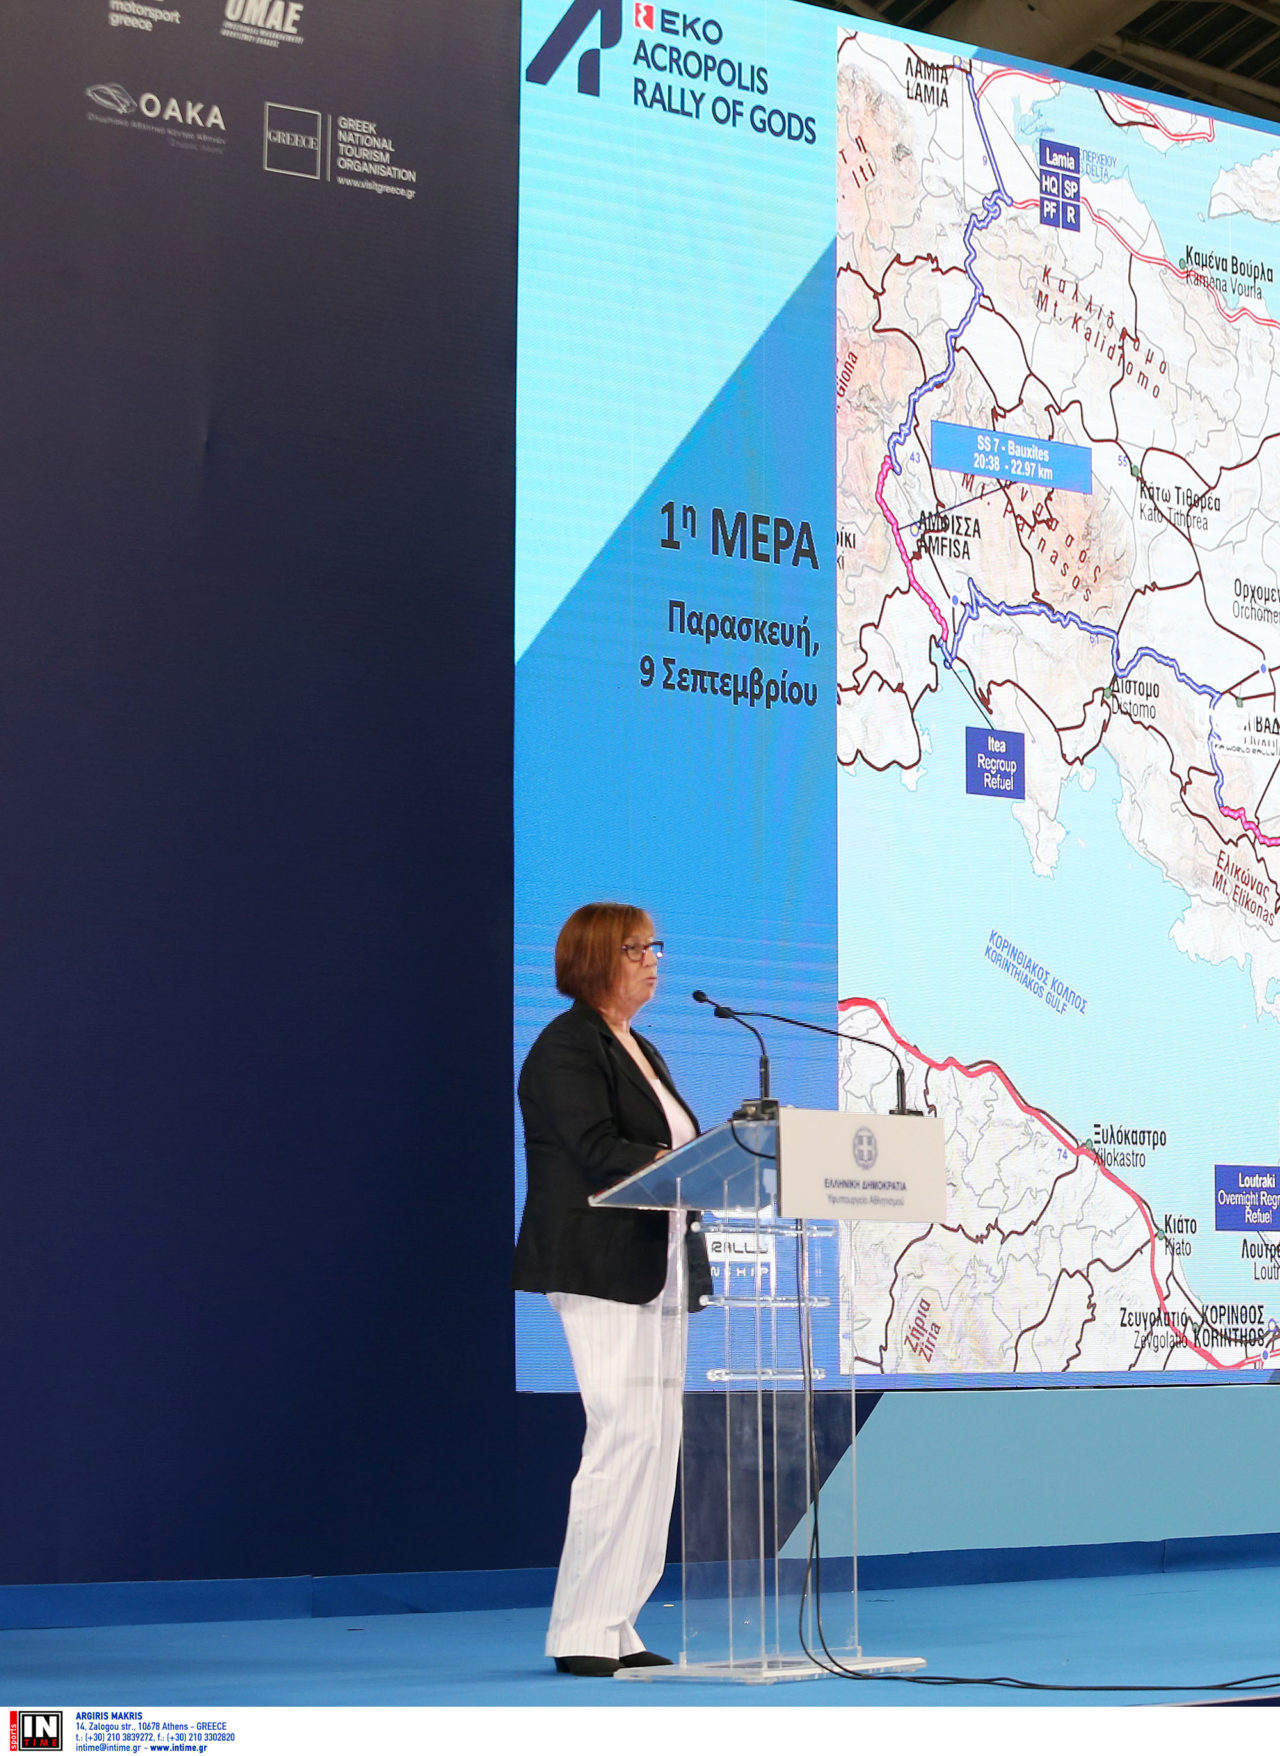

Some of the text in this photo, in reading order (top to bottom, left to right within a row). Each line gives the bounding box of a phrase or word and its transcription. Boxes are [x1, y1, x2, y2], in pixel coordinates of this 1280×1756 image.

[108, 12, 153, 31] greece
[109, 0, 181, 24] motorsport
[661, 9, 723, 45] EKO
[633, 39, 769, 95] ACROPOLIS
[906, 79, 949, 108] LAMIA
[634, 77, 817, 145] RALLY OF GODS
[337, 116, 377, 135] GREEK
[268, 130, 319, 151] GREECE
[337, 130, 395, 152] NATIONAL
[337, 144, 390, 164] TOURISM
[1045, 146, 1075, 170] Lamia
[337, 157, 417, 183] ORGANISATION
[337, 176, 416, 199] www.visitgreece.gr
[1042, 174, 1078, 200] HQ SP
[1043, 202, 1076, 225] PF R
[1186, 245, 1274, 283] Καμένα Βούρλα
[1231, 277, 1262, 300] Vourla
[837, 351, 858, 399] Giona
[977, 434, 1049, 462] SS Bauxites
[974, 454, 1053, 480] 20:38 22.97 km
[1139, 480, 1171, 503] Κάτω
[712, 508, 820, 570] ΜΕΡΑ
[920, 534, 970, 560] AMFISA
[668, 599, 820, 657] Παρασκευή,
[640, 655, 818, 709] 9 Σεπτεμβρίου
[1112, 698, 1157, 719] Distomo
[988, 736, 1006, 753] Itea
[977, 755, 1017, 775] Regroup
[984, 771, 1014, 792] Refuel
[1217, 850, 1270, 904] Ελικώνας
[1212, 871, 1275, 927] Mt. Elikonas
[984, 945, 1067, 1015] KORINTHIAKOS GULF
[989, 929, 1088, 1015] ΚΟΡΙΝΘΙΑΚΟΣ ΚΟΛΠΟΣ
[1094, 1124, 1166, 1151] Ξυλόκαστρο
[1239, 1173, 1276, 1189] Loutraki
[1218, 1190, 1258, 1207] Overnight
[1164, 1214, 1197, 1235] Κιάτο
[1245, 1208, 1272, 1224] Refuel
[904, 1297, 931, 1354] Ζήρια
[1201, 1305, 1264, 1326] ΚΟΡΙΝΘΟΣ
[919, 1322, 941, 1363] Ziria
[1194, 1327, 1264, 1348] KORINTHOS
